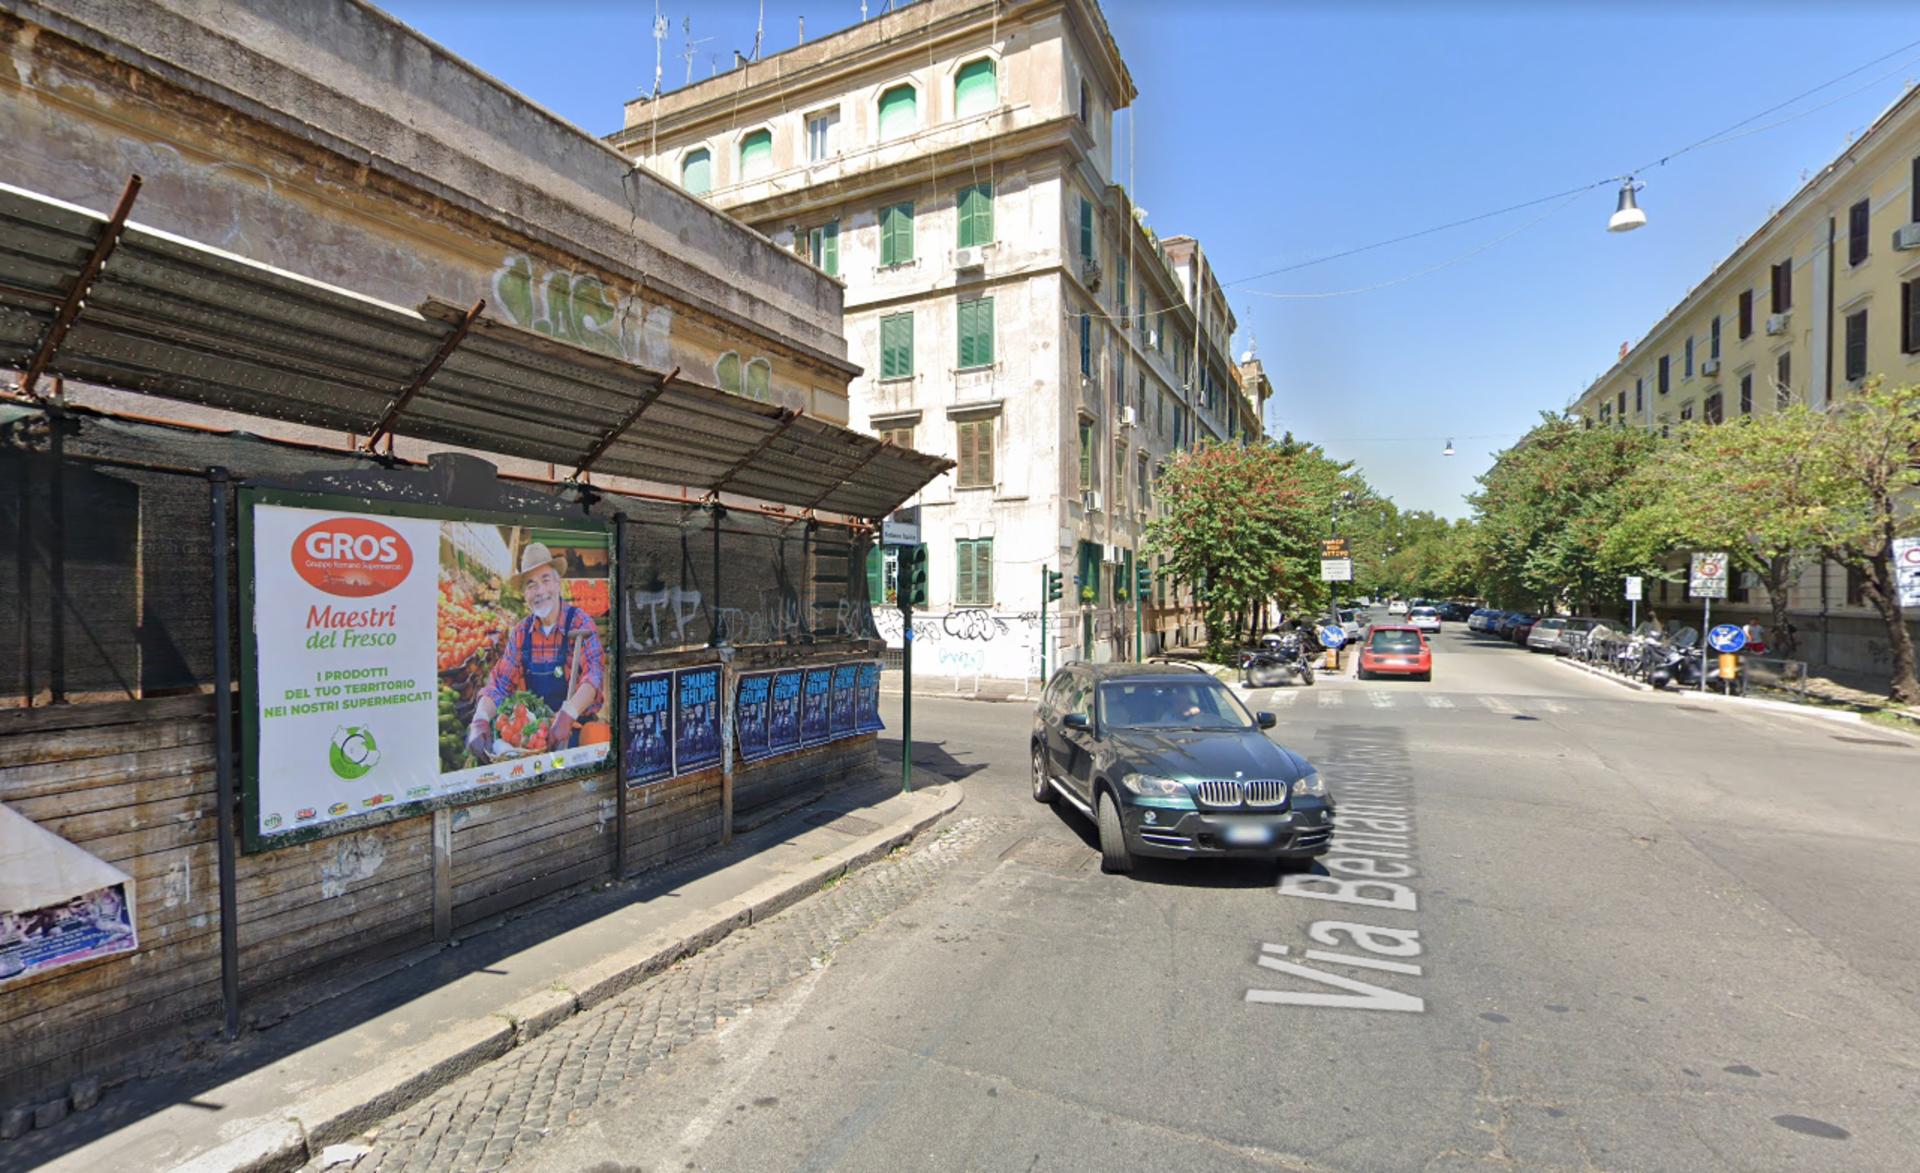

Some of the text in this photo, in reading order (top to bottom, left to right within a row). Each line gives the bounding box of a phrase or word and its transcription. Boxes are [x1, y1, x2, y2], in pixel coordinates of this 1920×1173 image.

[305, 531, 398, 562] GROS
[306, 604, 396, 629] Maestri
[306, 629, 397, 649] del Fresco
[317, 667, 388, 682] I PRODOTTI
[284, 680, 416, 700] DEL TUO TERRITORIO
[264, 691, 432, 718] NEI NOSTRI SUPERMERCATI
